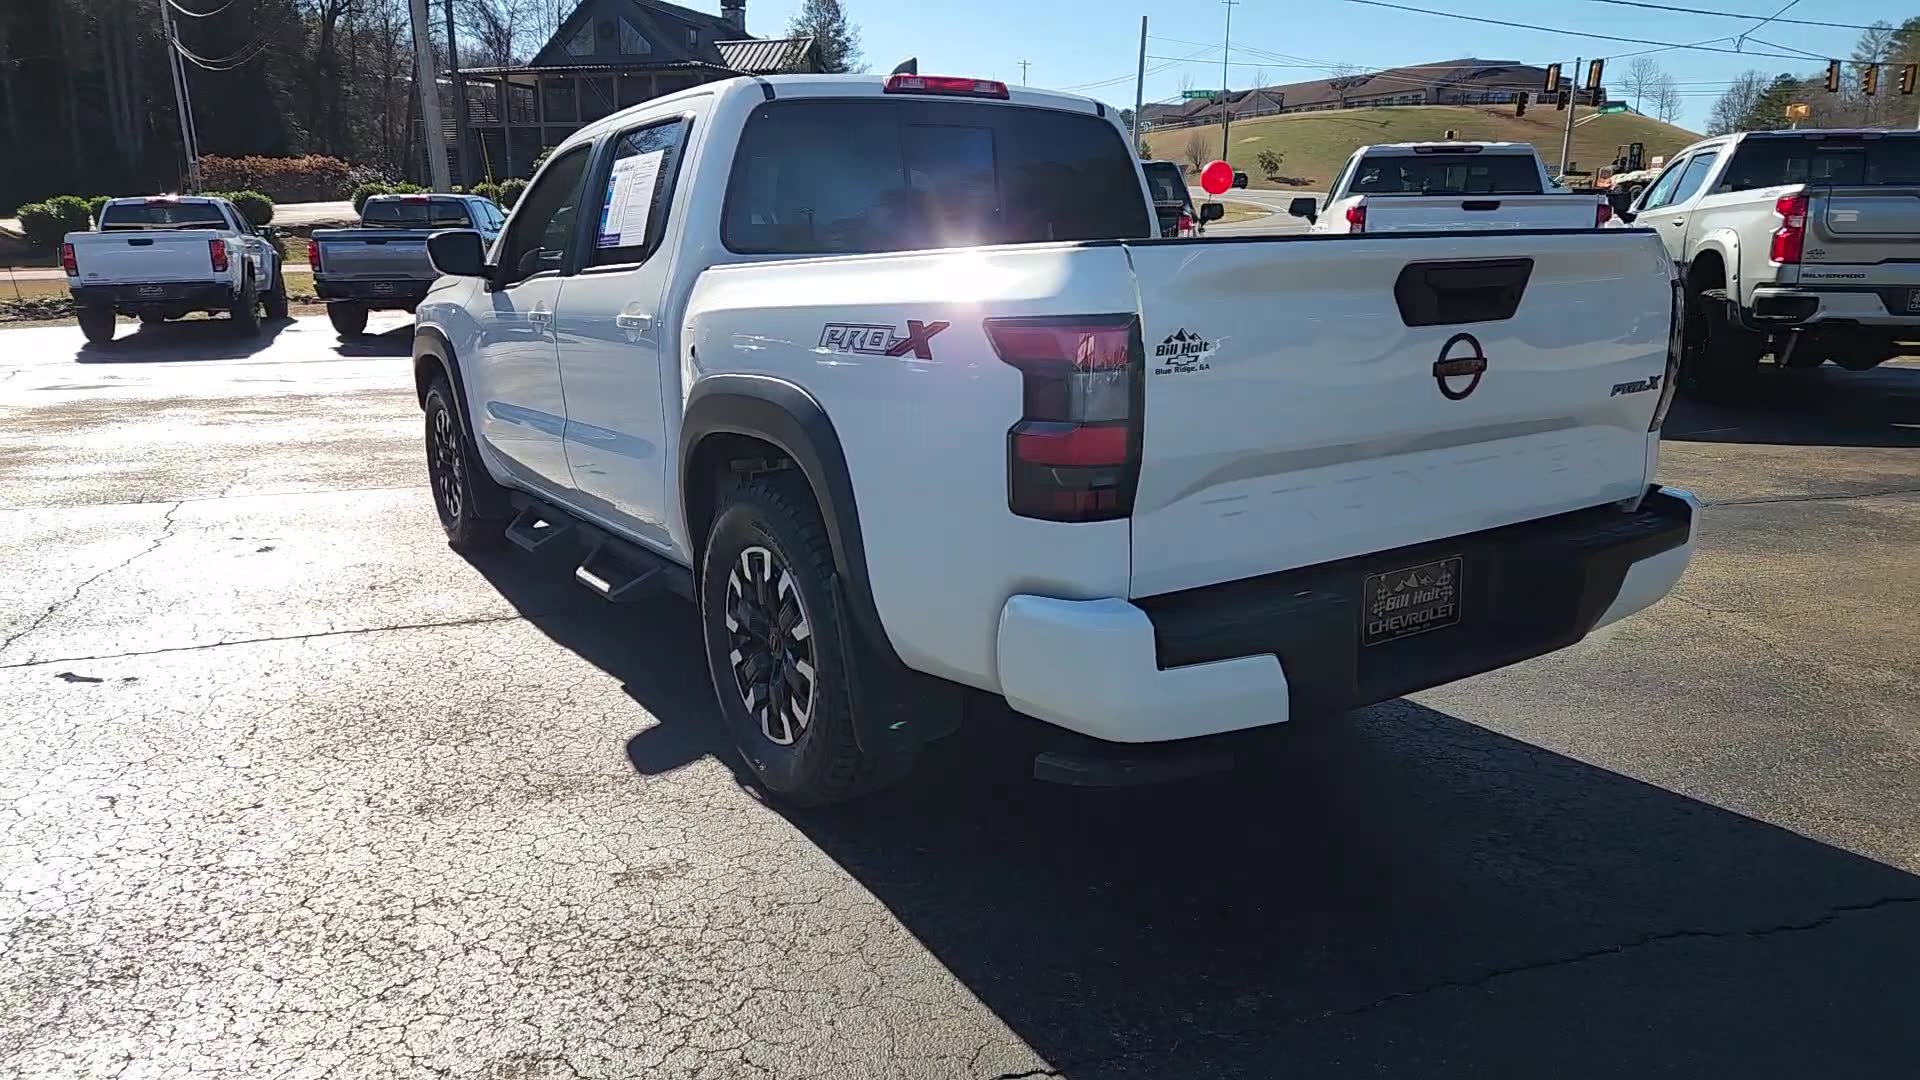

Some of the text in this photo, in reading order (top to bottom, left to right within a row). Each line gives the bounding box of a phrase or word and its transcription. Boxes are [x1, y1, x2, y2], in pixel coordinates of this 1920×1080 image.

[1155, 341, 1210, 356] Bill Holt
[1386, 587, 1442, 611] Bill Holt
[1369, 604, 1455, 634] CHEVROLET
